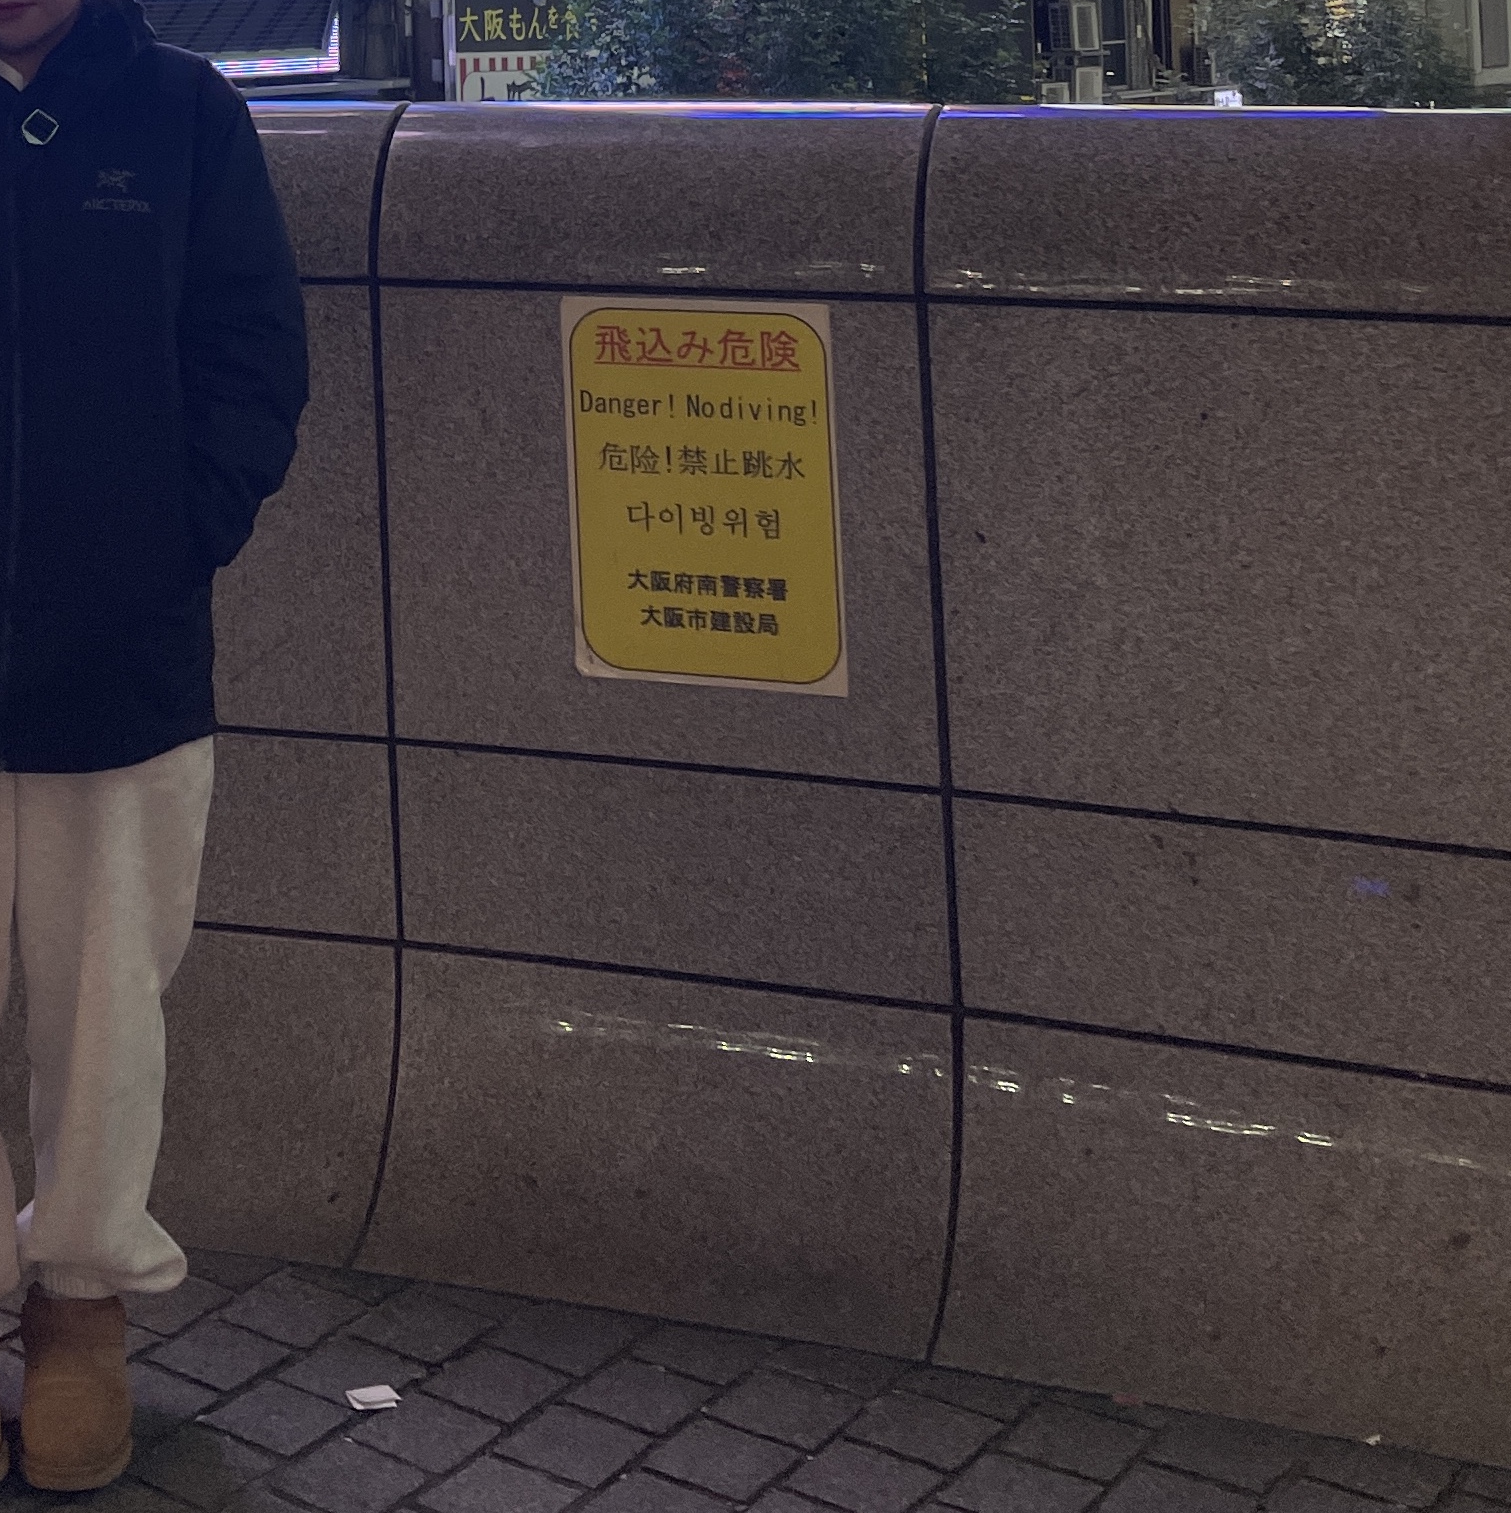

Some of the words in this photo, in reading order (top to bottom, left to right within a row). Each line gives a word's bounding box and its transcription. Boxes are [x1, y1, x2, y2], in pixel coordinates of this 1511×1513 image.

[594, 324, 802, 370] 飛込み危険
[579, 388, 675, 419] Danger!
[627, 568, 789, 602] 大阪府南警察署
[639, 604, 780, 637] 大阪市建設局
